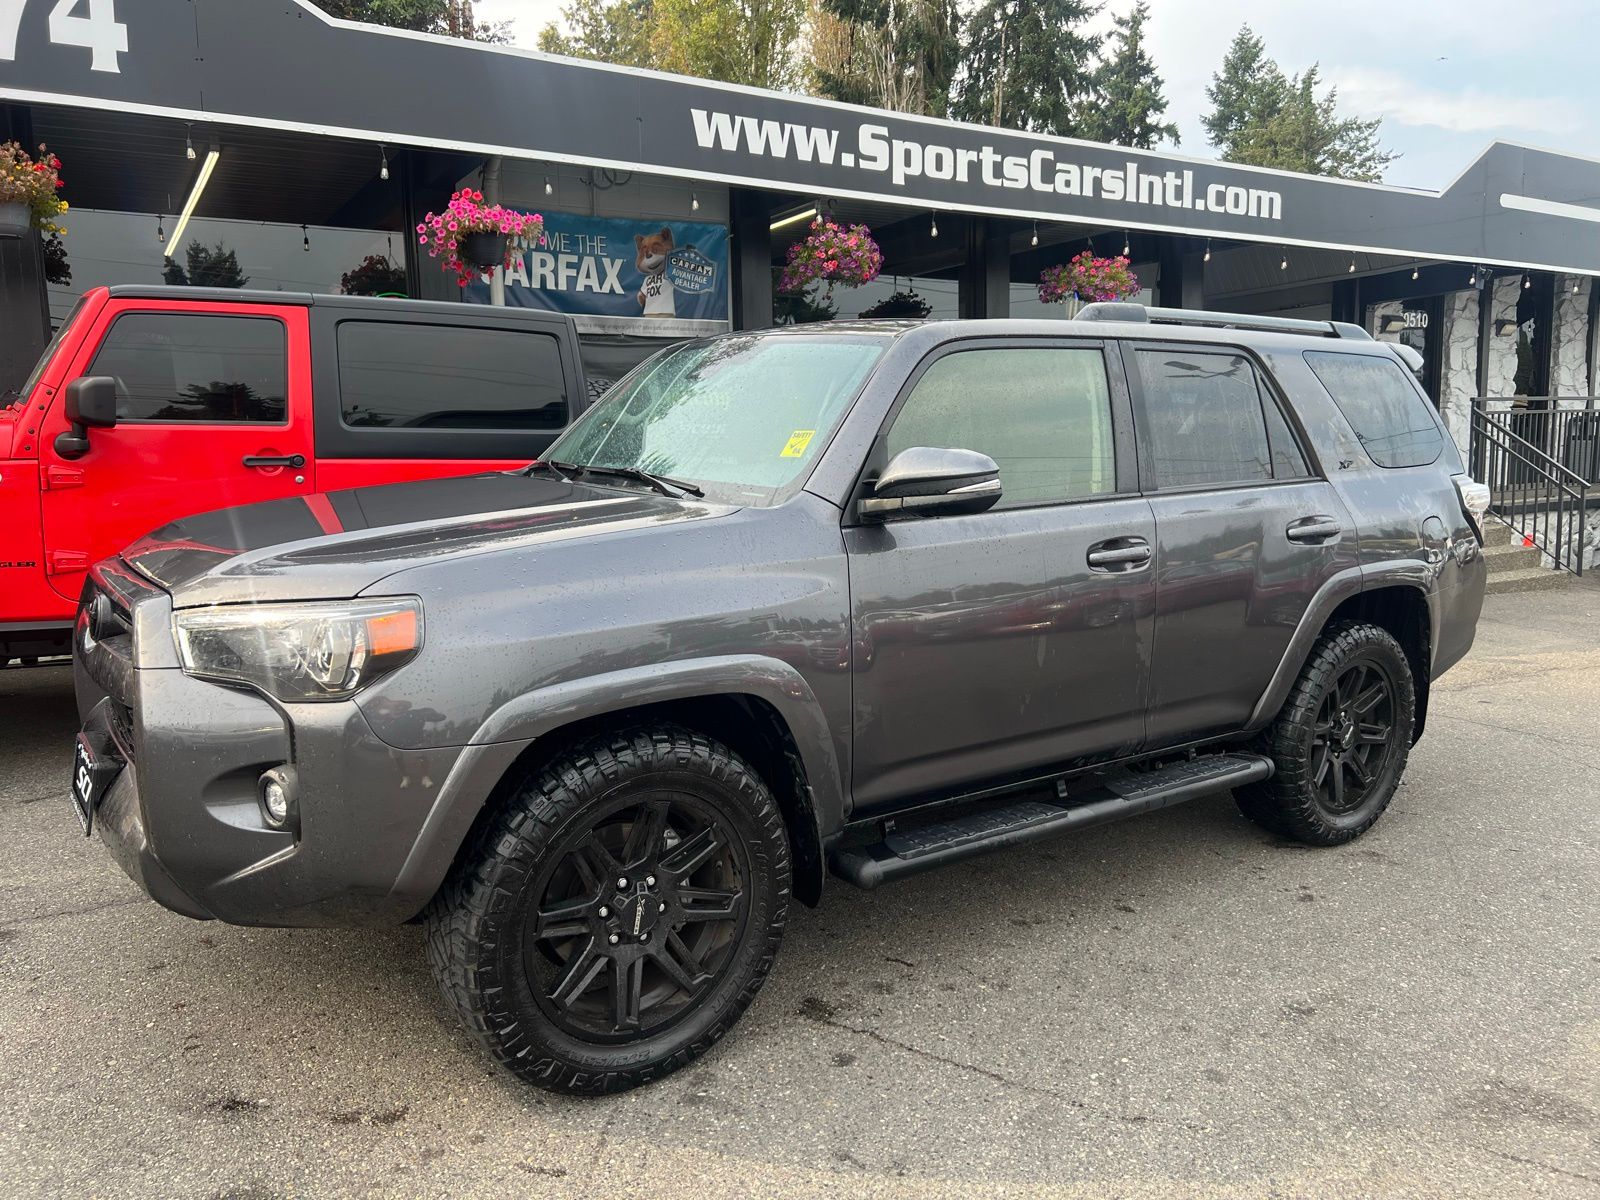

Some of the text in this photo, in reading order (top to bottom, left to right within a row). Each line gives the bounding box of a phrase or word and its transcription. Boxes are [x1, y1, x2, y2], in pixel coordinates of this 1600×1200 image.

[690, 108, 1282, 220] www.SportsCarsIntl.com
[543, 230, 571, 252] ME
[575, 234, 608, 256] THE
[481, 251, 625, 295] ARFAX
[671, 257, 713, 276] CARFAX
[645, 274, 663, 287] CAR
[671, 268, 708, 284] ADVANTAGE
[674, 278, 700, 291] DEALER
[646, 285, 661, 297] FOX
